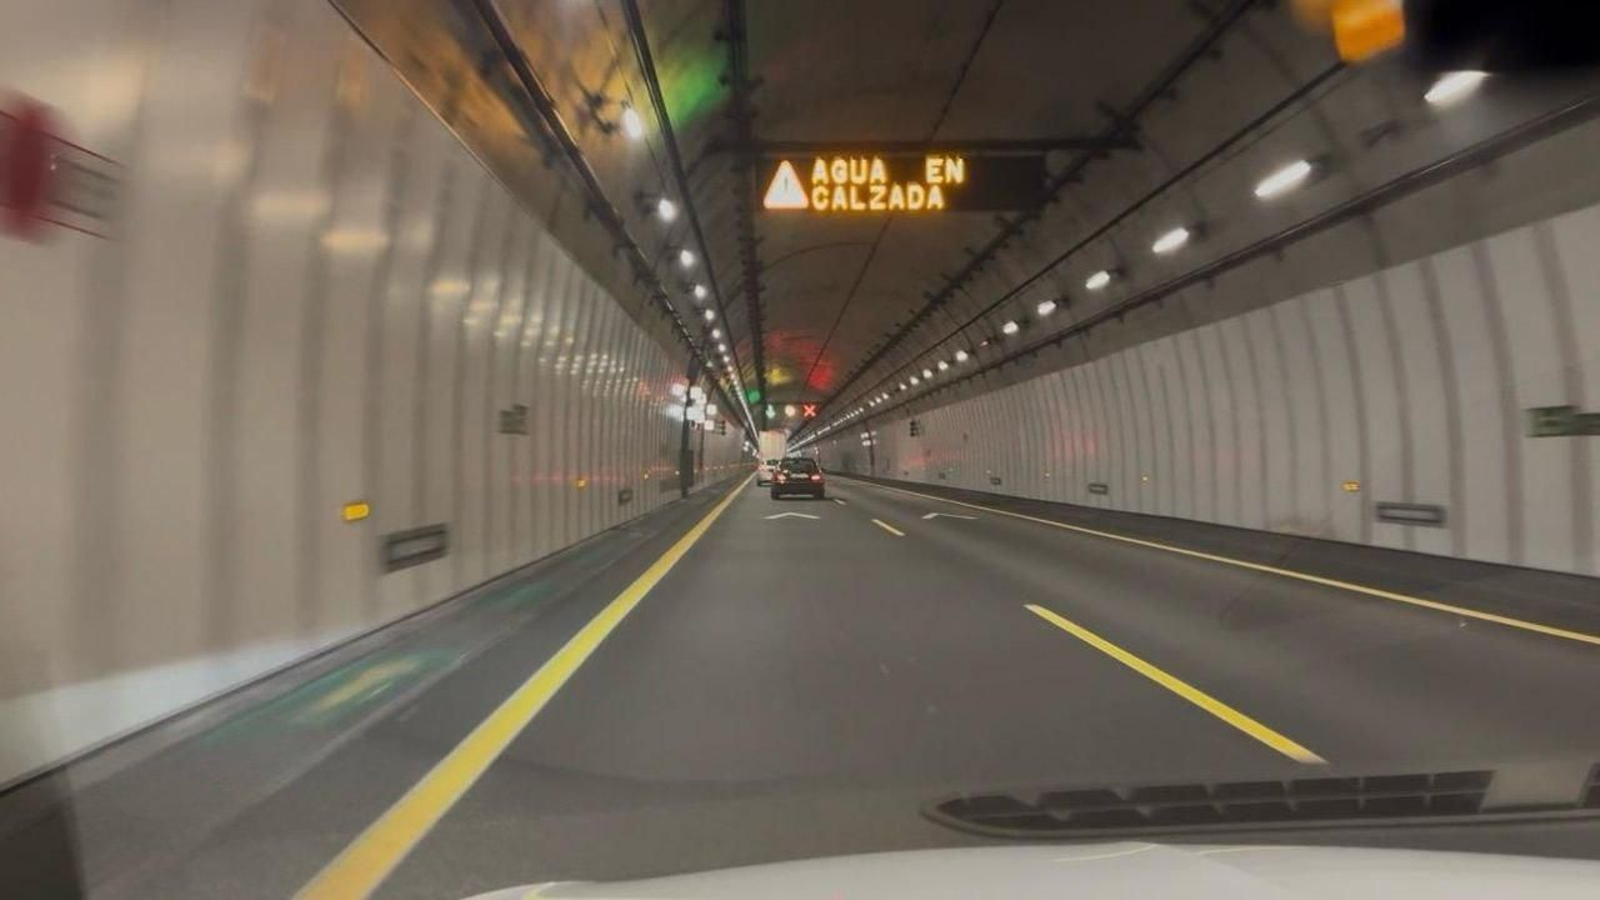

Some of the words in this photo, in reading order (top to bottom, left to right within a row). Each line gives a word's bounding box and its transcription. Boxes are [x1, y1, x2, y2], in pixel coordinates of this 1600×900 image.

[811, 156, 886, 184] AGUA
[925, 156, 965, 184] EN
[811, 184, 945, 210] CALZADA
